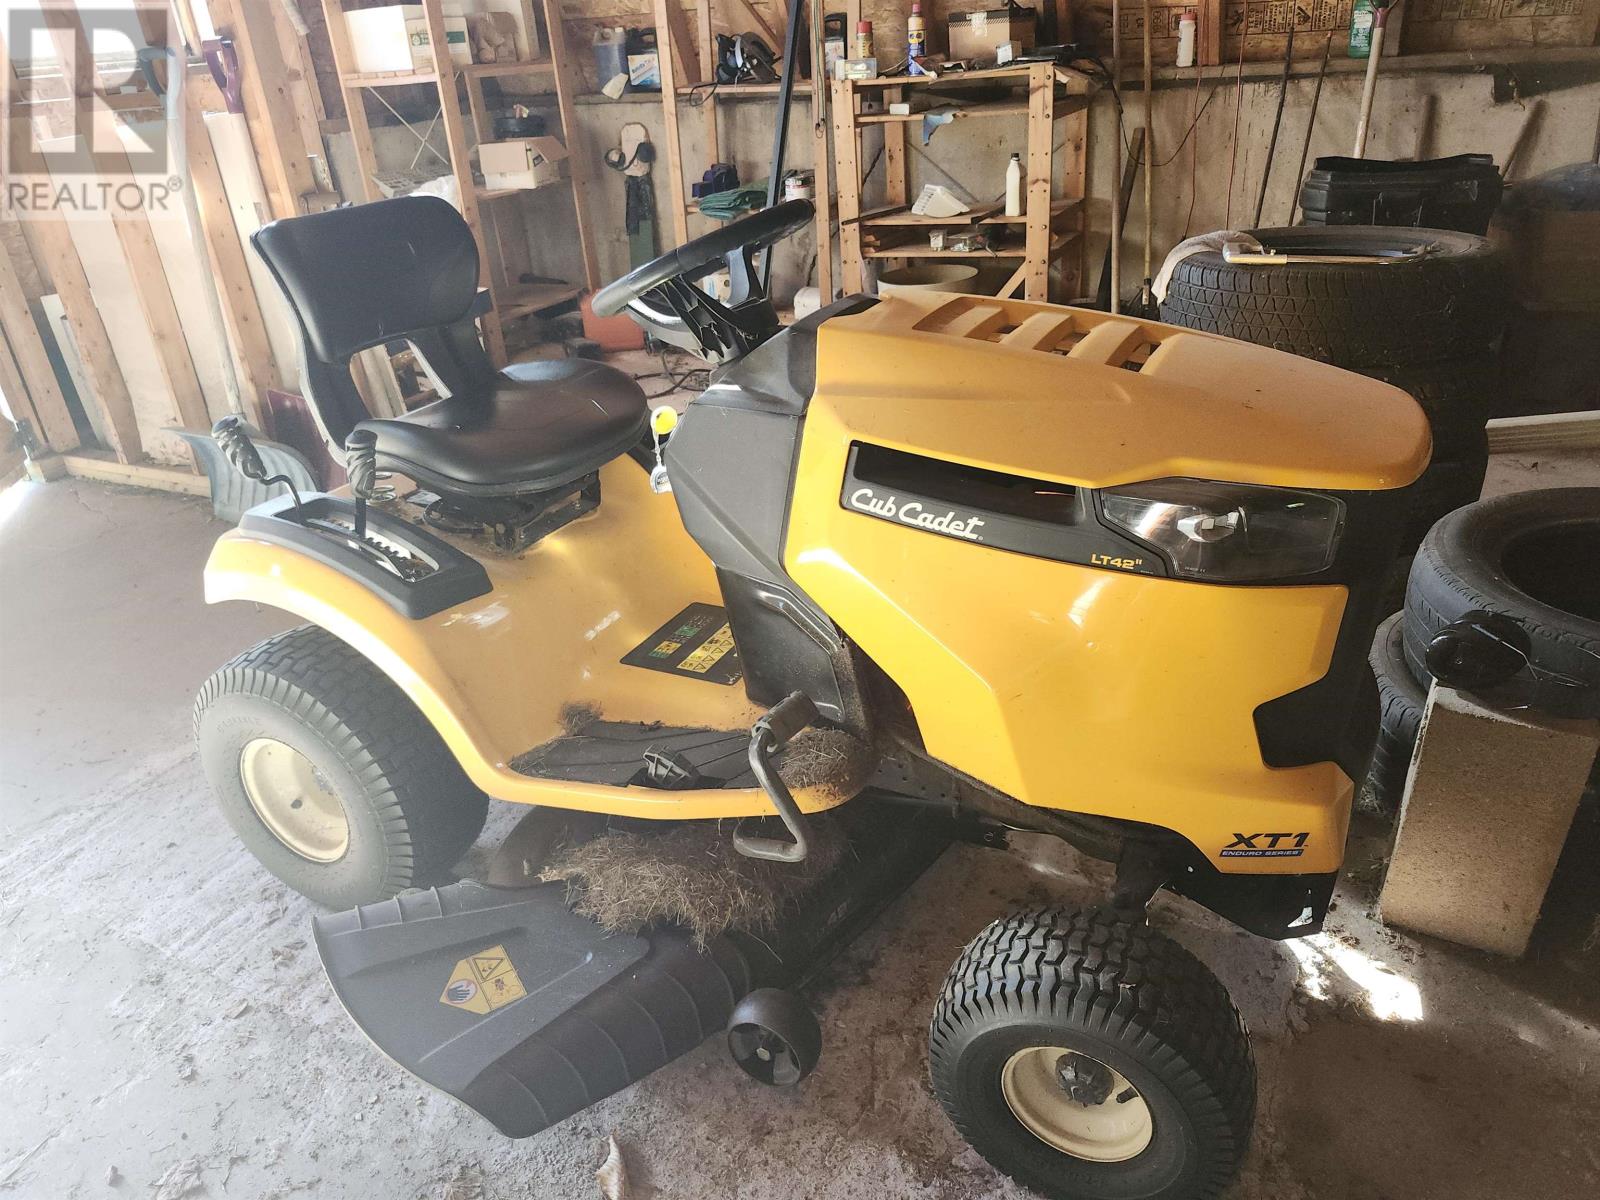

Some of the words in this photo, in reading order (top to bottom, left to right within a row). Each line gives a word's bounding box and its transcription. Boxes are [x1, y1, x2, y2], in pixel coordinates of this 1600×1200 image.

[850, 488, 897, 517] Cub
[1090, 553, 1143, 570] LT42"
[1224, 832, 1310, 848] XT1
